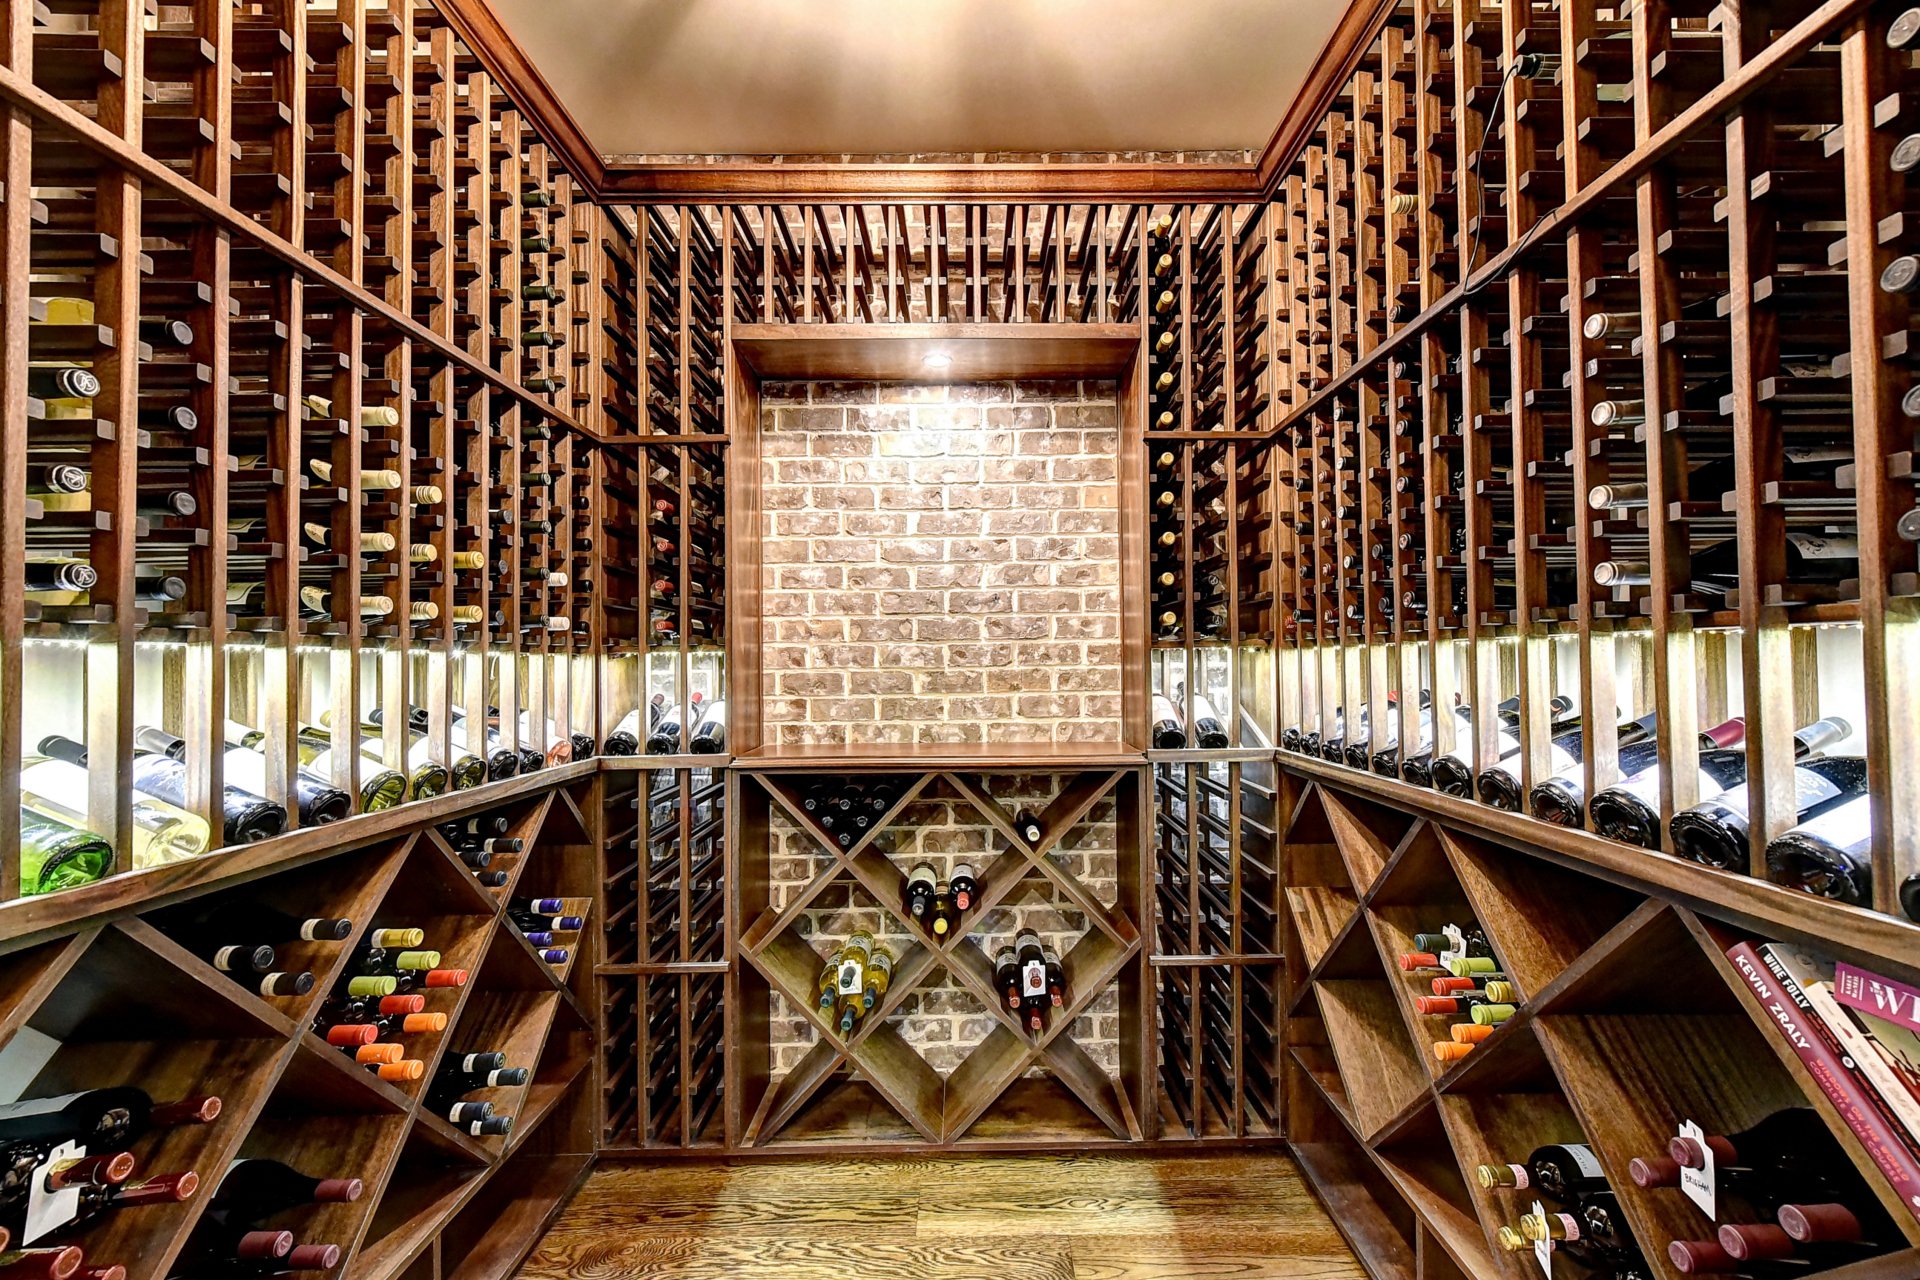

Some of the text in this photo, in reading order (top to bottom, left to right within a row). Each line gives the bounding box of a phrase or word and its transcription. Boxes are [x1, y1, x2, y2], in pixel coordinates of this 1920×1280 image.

[1735, 954, 1811, 1048] KEVIN ZRALY
[1763, 953, 1811, 1009] WINE FOLLY
[1809, 1061, 1847, 1109] COMPLETE
[1847, 1112, 1868, 1138] WINE
[1867, 1140, 1902, 1183] COURSE
